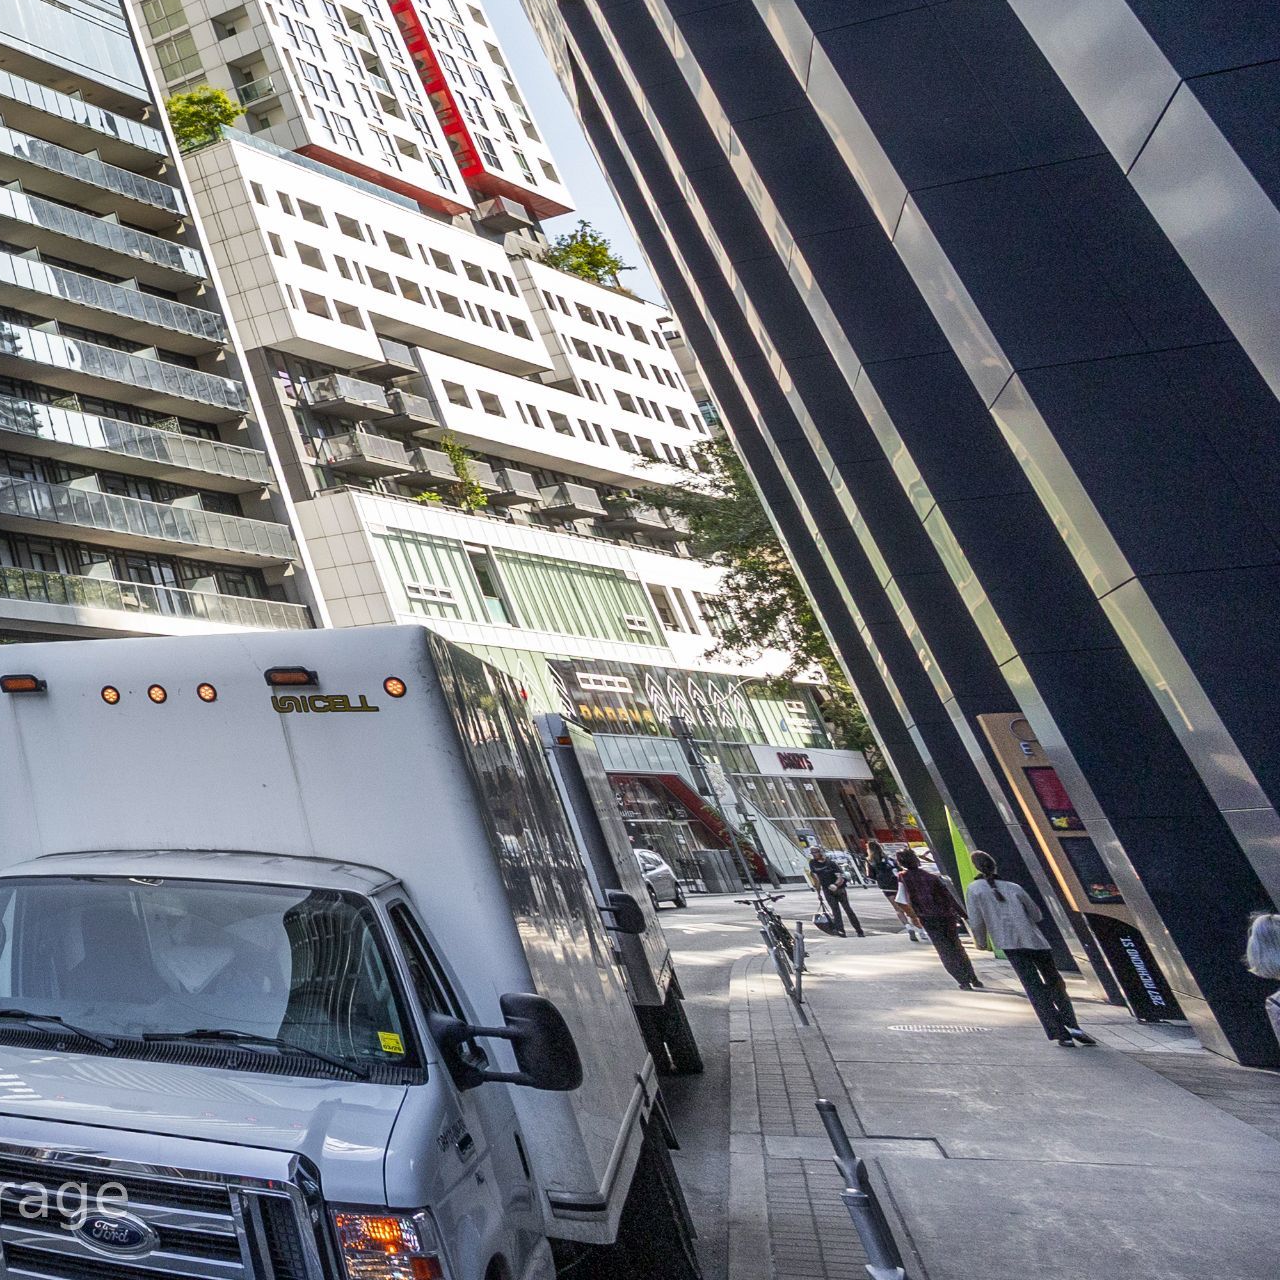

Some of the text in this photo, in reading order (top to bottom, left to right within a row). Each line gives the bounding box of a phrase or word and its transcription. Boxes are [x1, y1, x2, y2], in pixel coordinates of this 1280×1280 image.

[1126, 949, 1157, 990] RICHMOND
[1147, 990, 1166, 1006] 287
[92, 1220, 129, 1243] Ford
